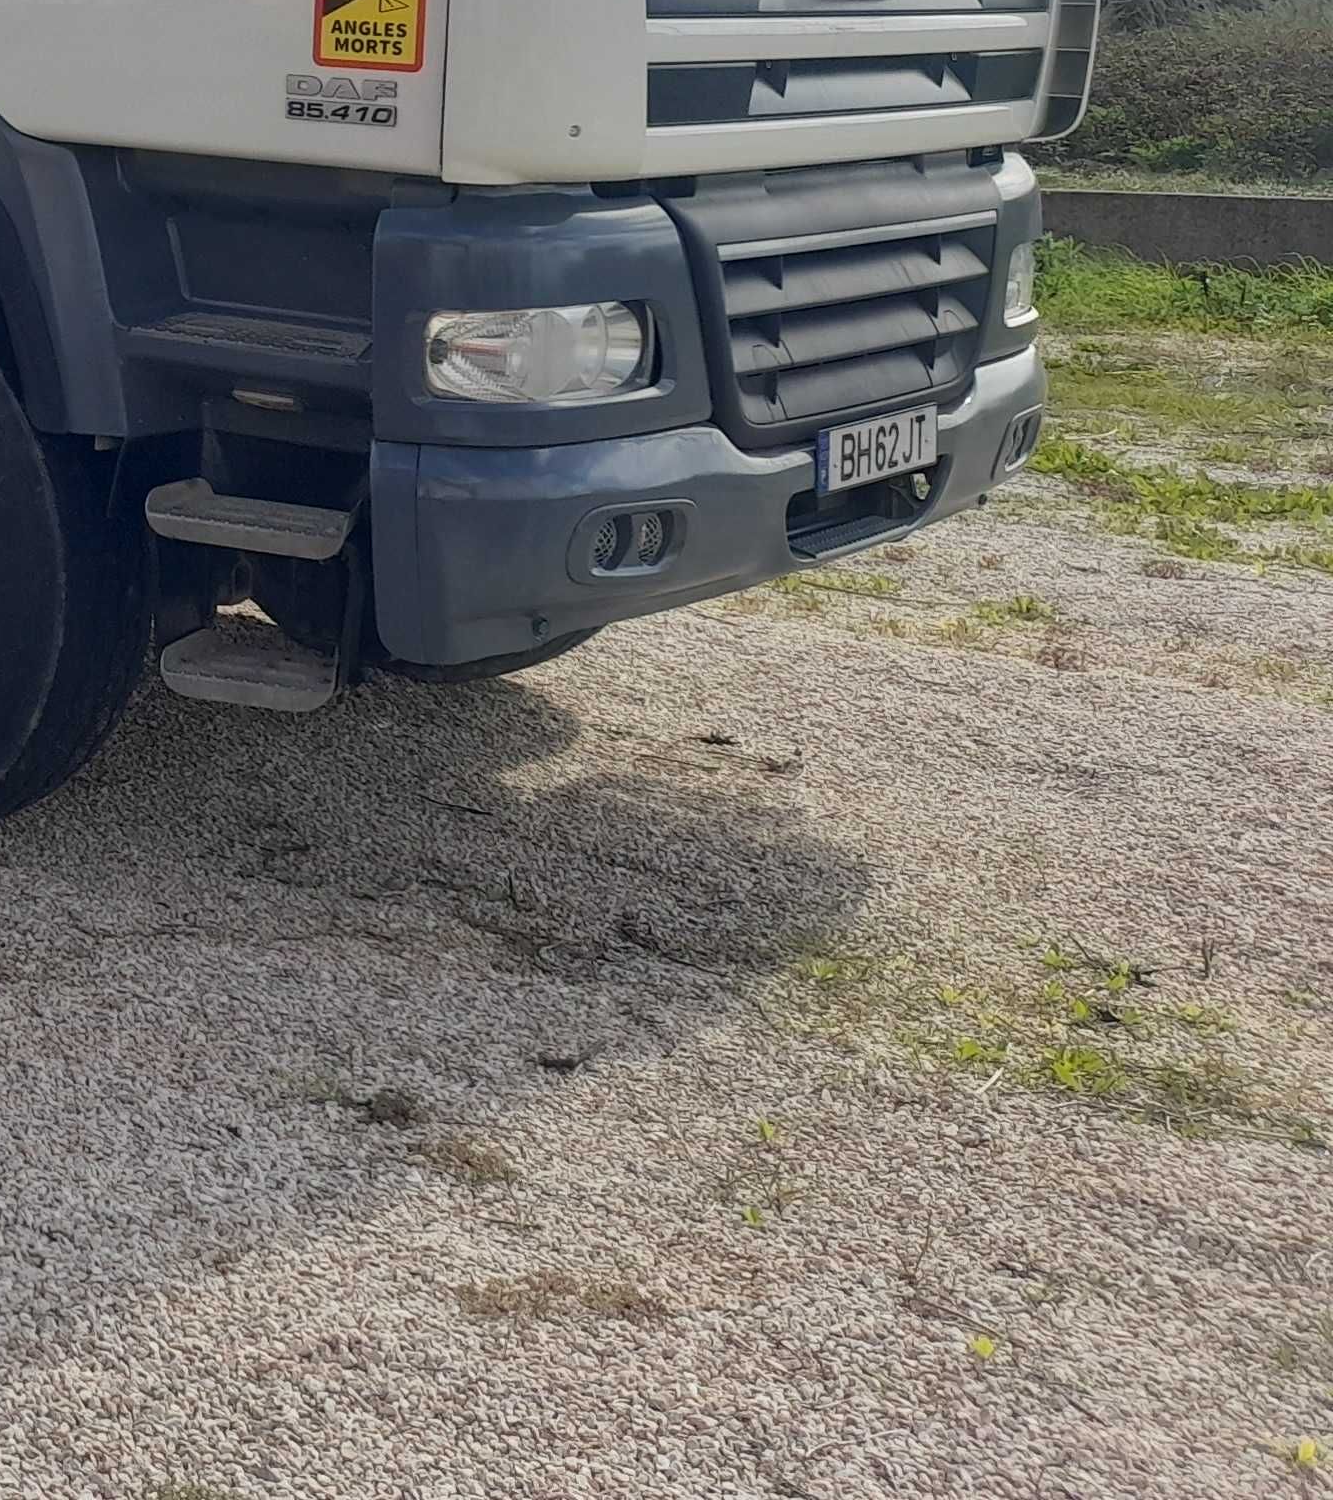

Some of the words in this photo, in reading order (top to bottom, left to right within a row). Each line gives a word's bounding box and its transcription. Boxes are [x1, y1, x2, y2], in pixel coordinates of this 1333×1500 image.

[330, 19, 408, 38] ANGLES
[334, 37, 403, 56] MORTS
[286, 73, 398, 101] DAF
[287, 101, 394, 125] 85.410
